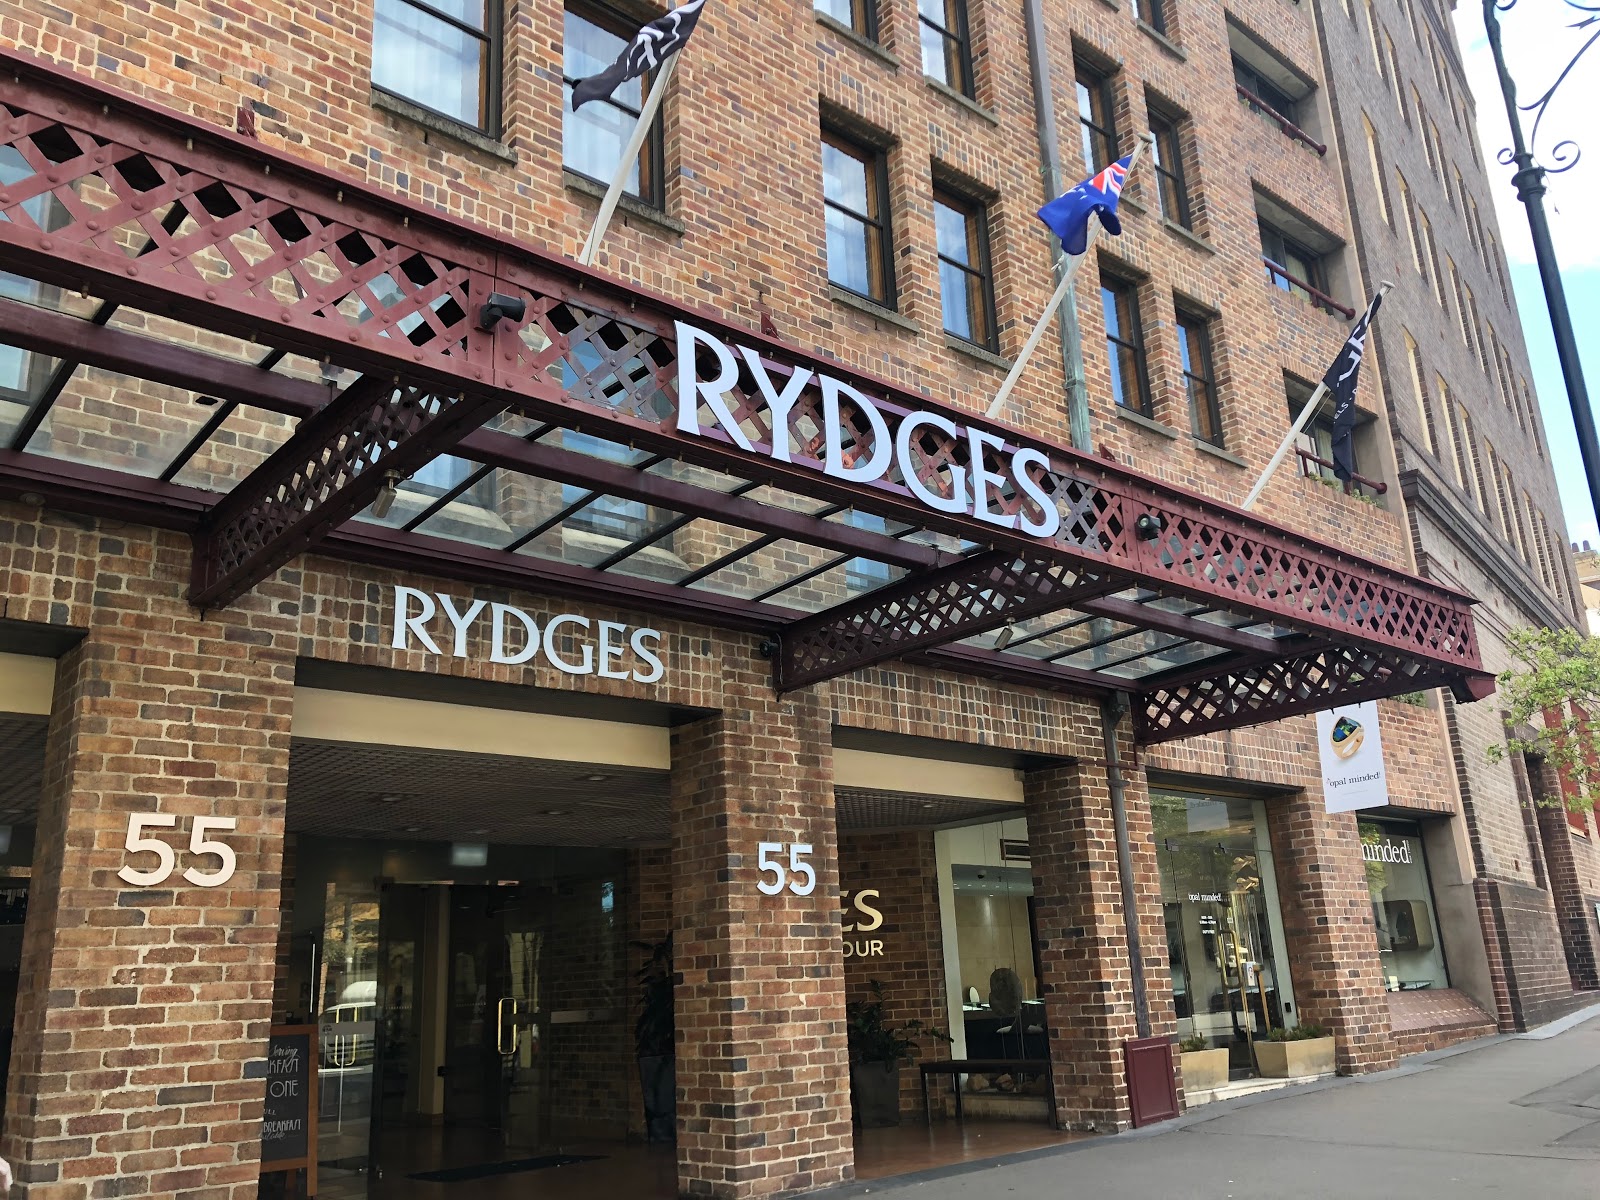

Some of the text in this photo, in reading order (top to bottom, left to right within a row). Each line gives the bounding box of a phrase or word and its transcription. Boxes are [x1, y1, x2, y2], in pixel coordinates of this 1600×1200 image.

[674, 320, 1060, 538] RYDGES
[391, 585, 664, 684] RYDGES
[117, 813, 236, 887] 55
[757, 842, 816, 896] 55
[270, 1080, 299, 1098] ONE
